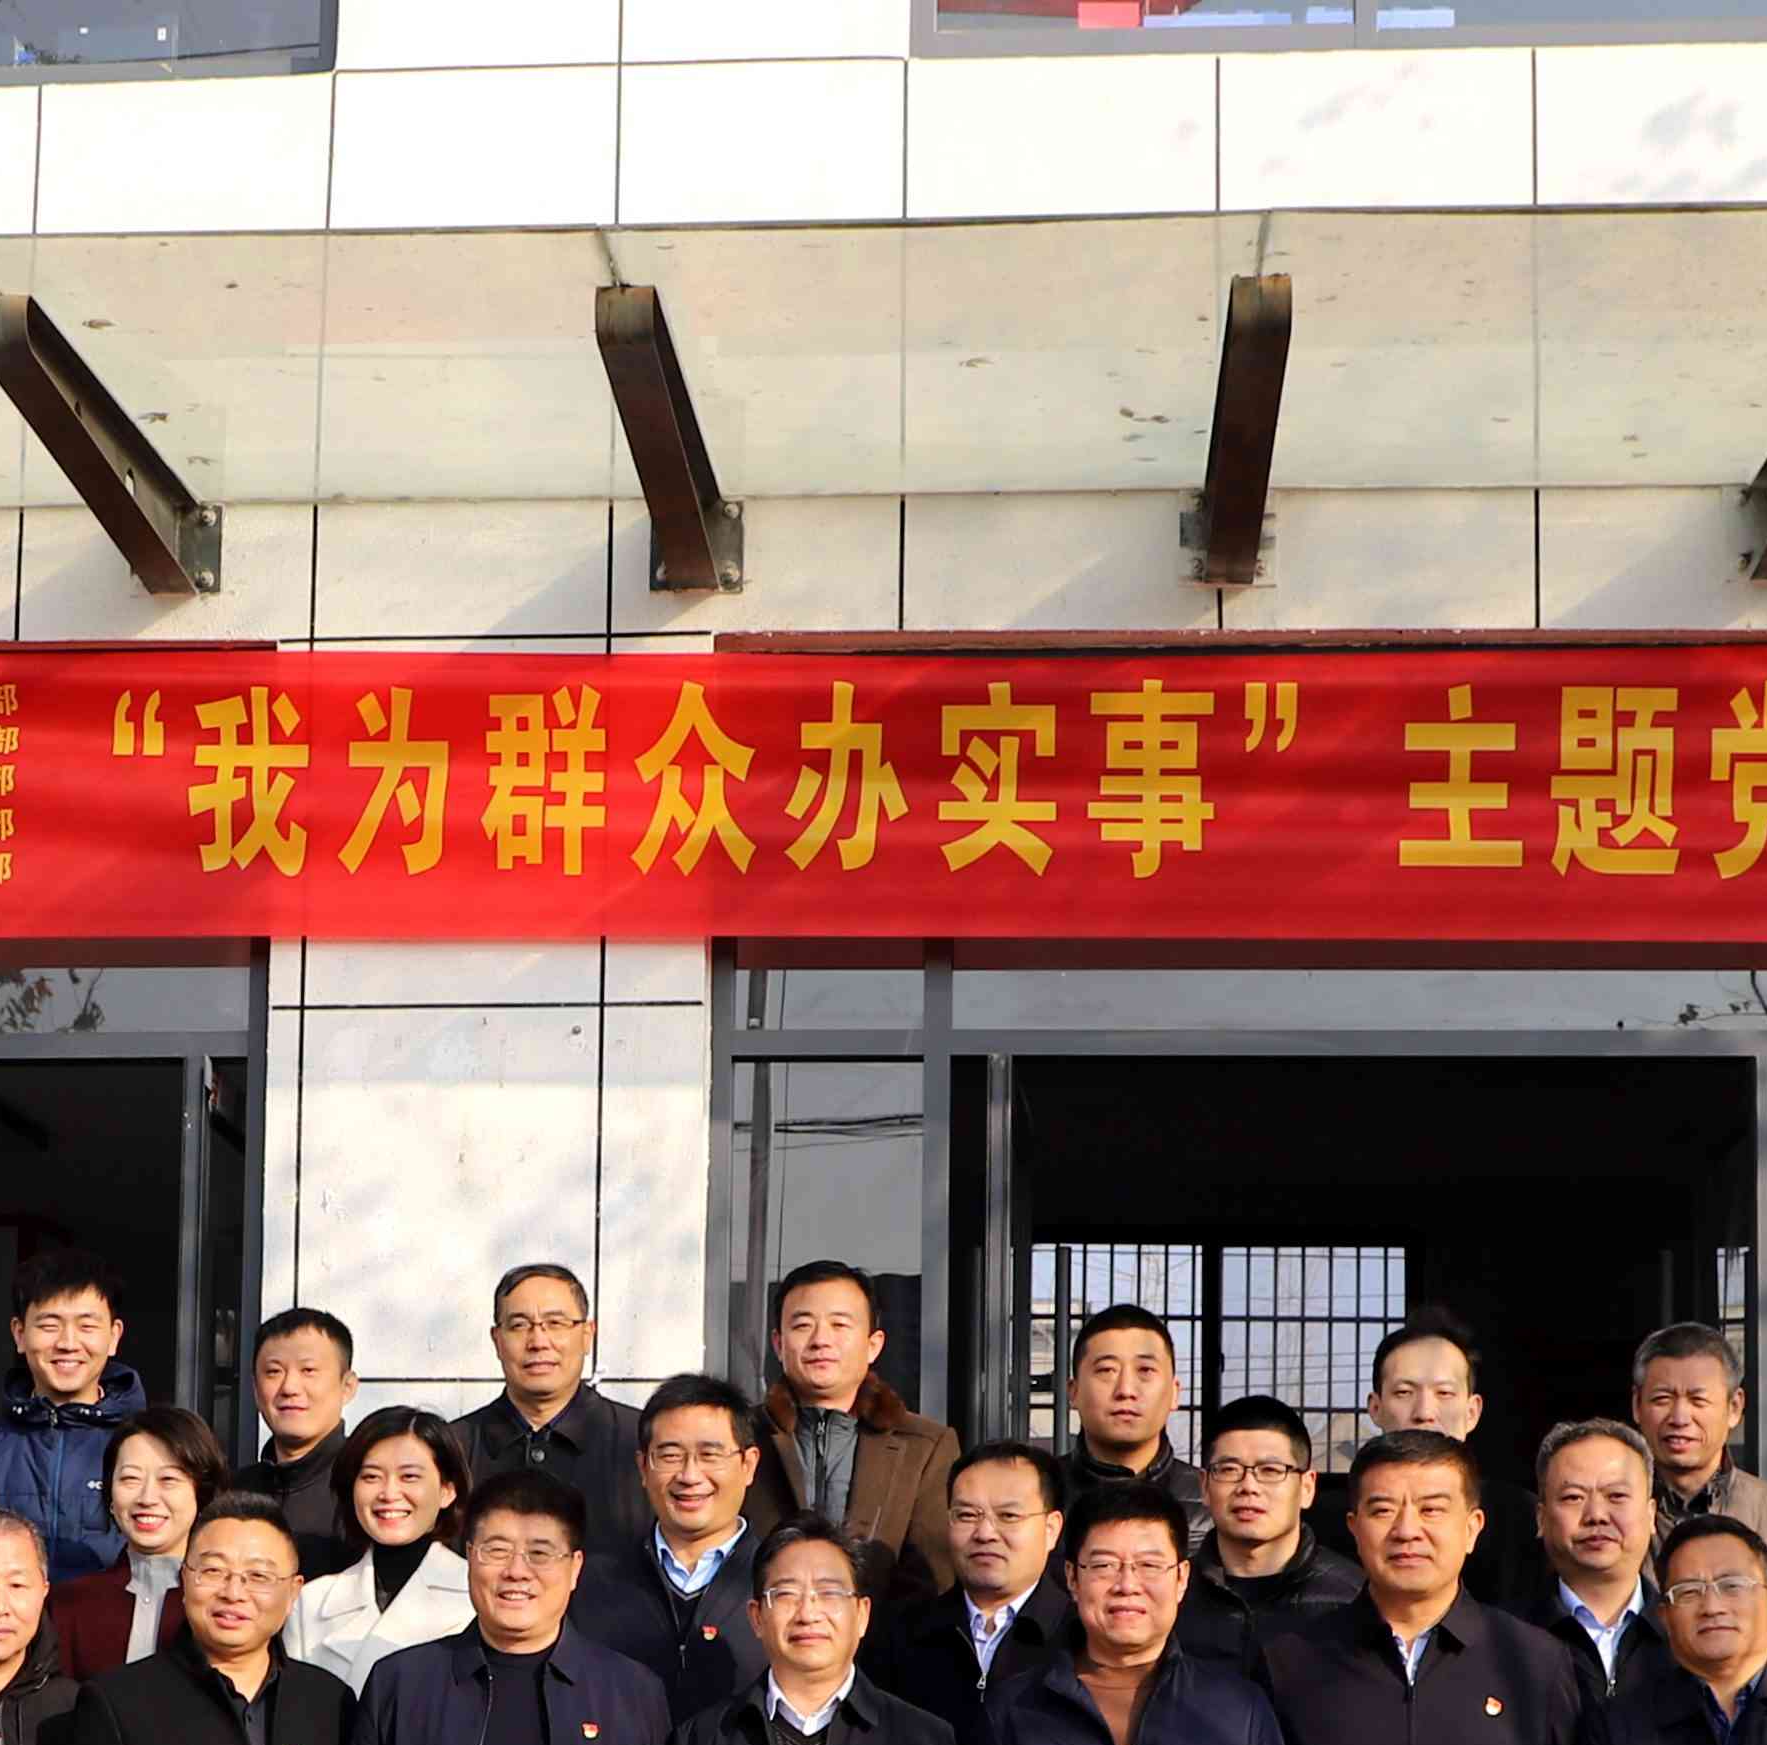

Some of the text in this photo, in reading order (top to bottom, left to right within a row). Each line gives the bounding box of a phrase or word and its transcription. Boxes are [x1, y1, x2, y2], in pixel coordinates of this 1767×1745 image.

[112, 679, 1299, 878] “我为群众办实事”
